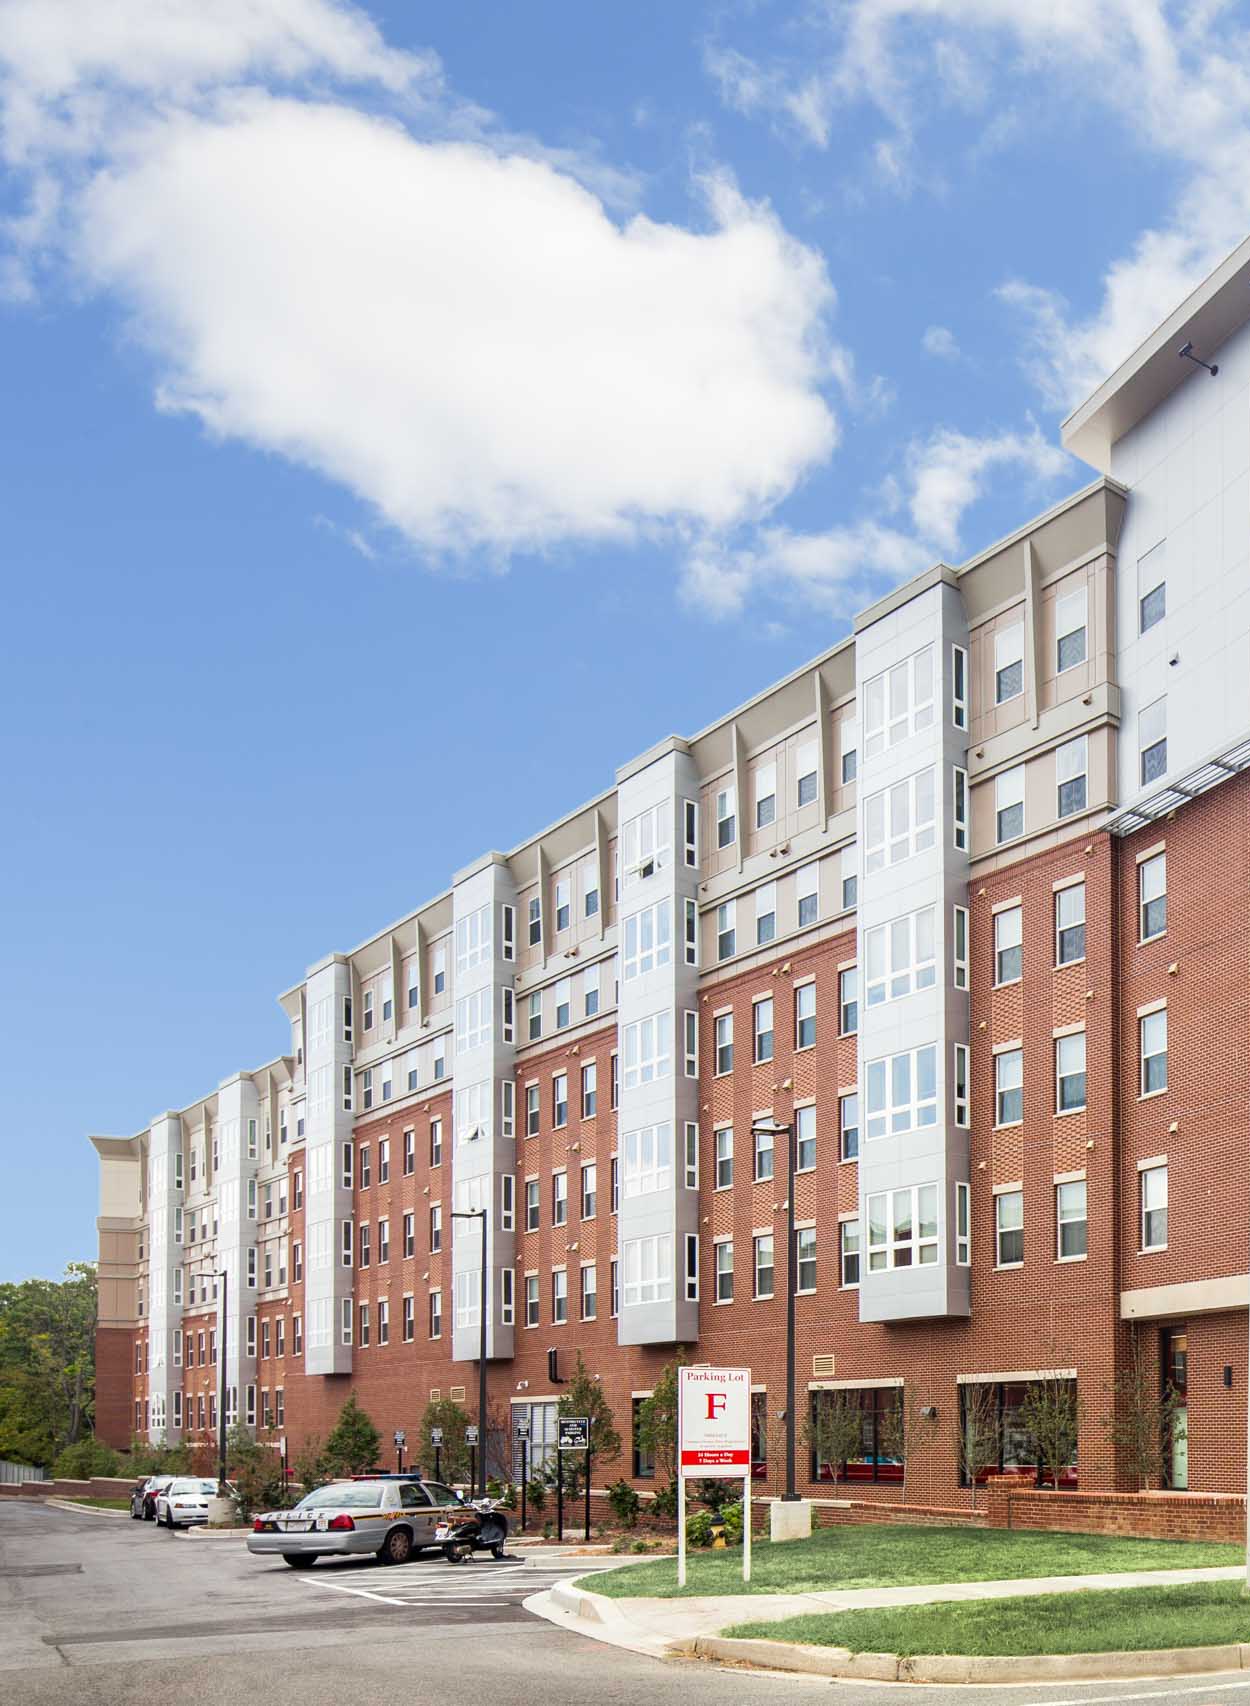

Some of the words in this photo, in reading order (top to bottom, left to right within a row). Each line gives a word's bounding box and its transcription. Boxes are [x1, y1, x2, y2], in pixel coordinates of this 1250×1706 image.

[687, 1372, 726, 1383] Parking
[728, 1373, 744, 1382] Lot
[704, 1393, 727, 1420] F
[266, 1512, 325, 1520] POLICE
